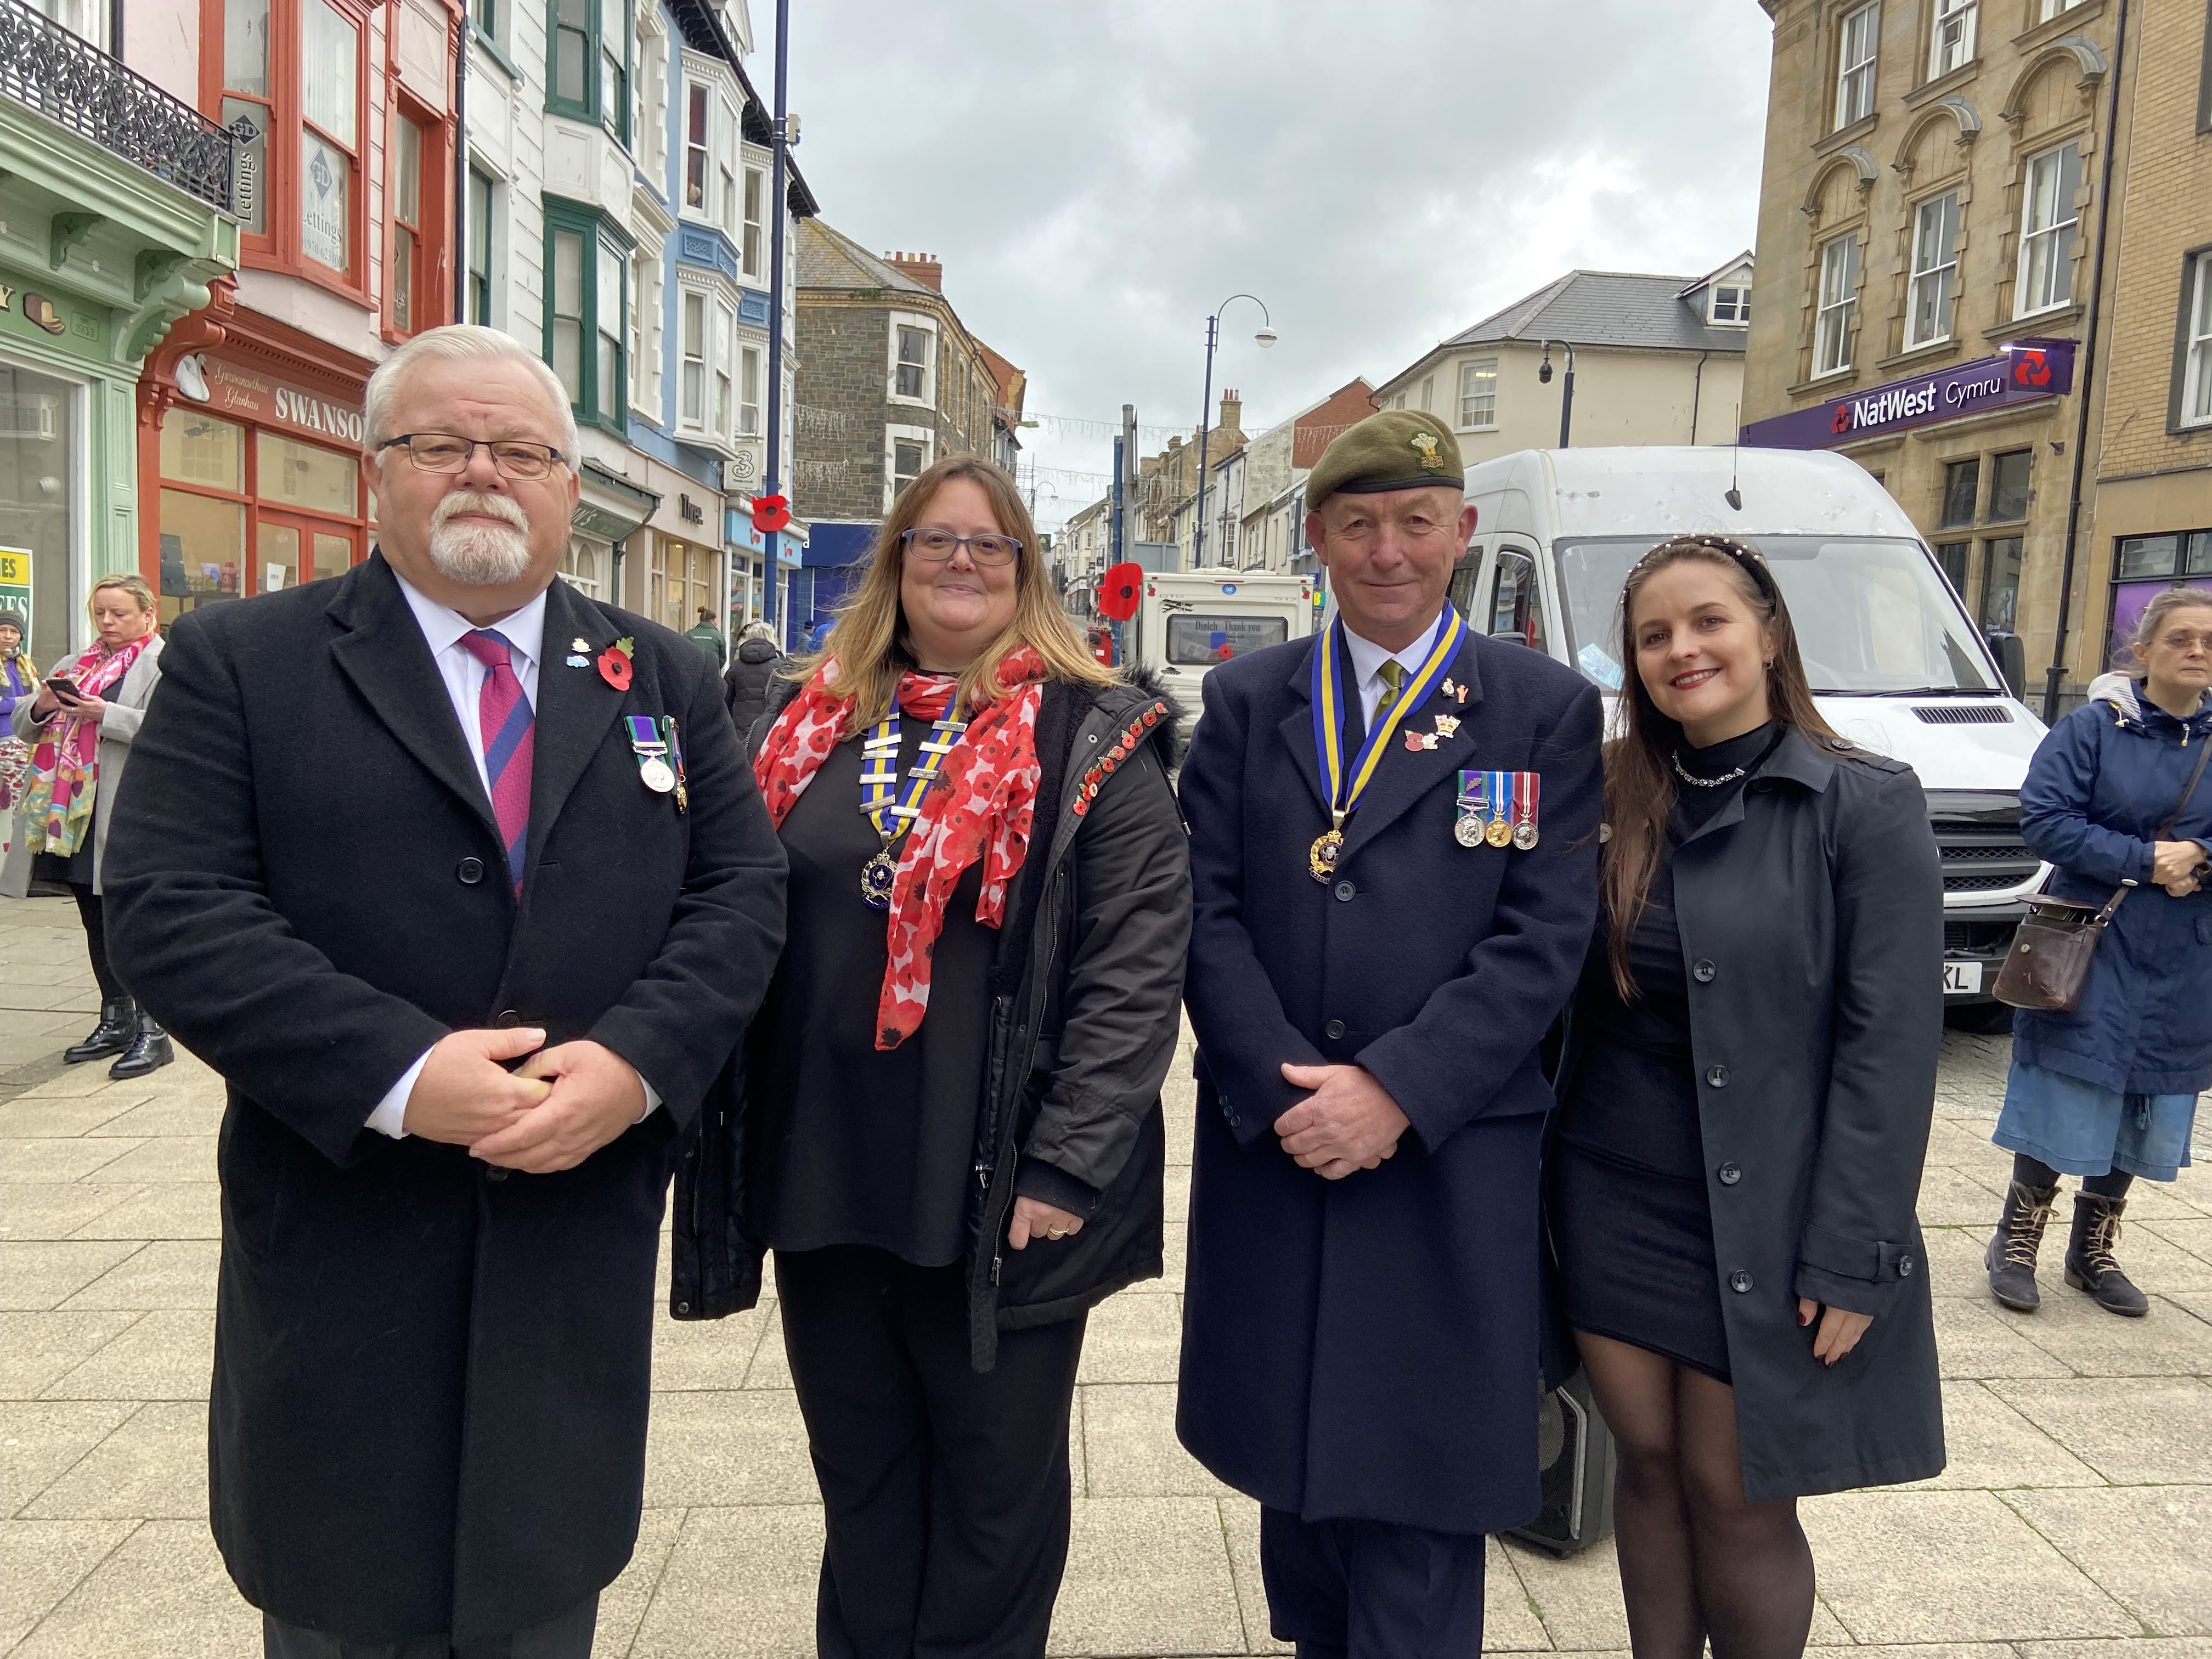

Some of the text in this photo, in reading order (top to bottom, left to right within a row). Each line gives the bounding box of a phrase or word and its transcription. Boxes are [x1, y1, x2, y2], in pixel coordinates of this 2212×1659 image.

[234, 121, 257, 137] GD
[312, 160, 330, 187] GD
[236, 151, 257, 223] Lettings
[302, 236, 319, 255] 1970
[225, 386, 258, 411] Glanhau
[1853, 377, 2001, 429] NatWest Cymru
[732, 450, 754, 478] 3
[1195, 620, 1261, 633] Diolch Thank you
